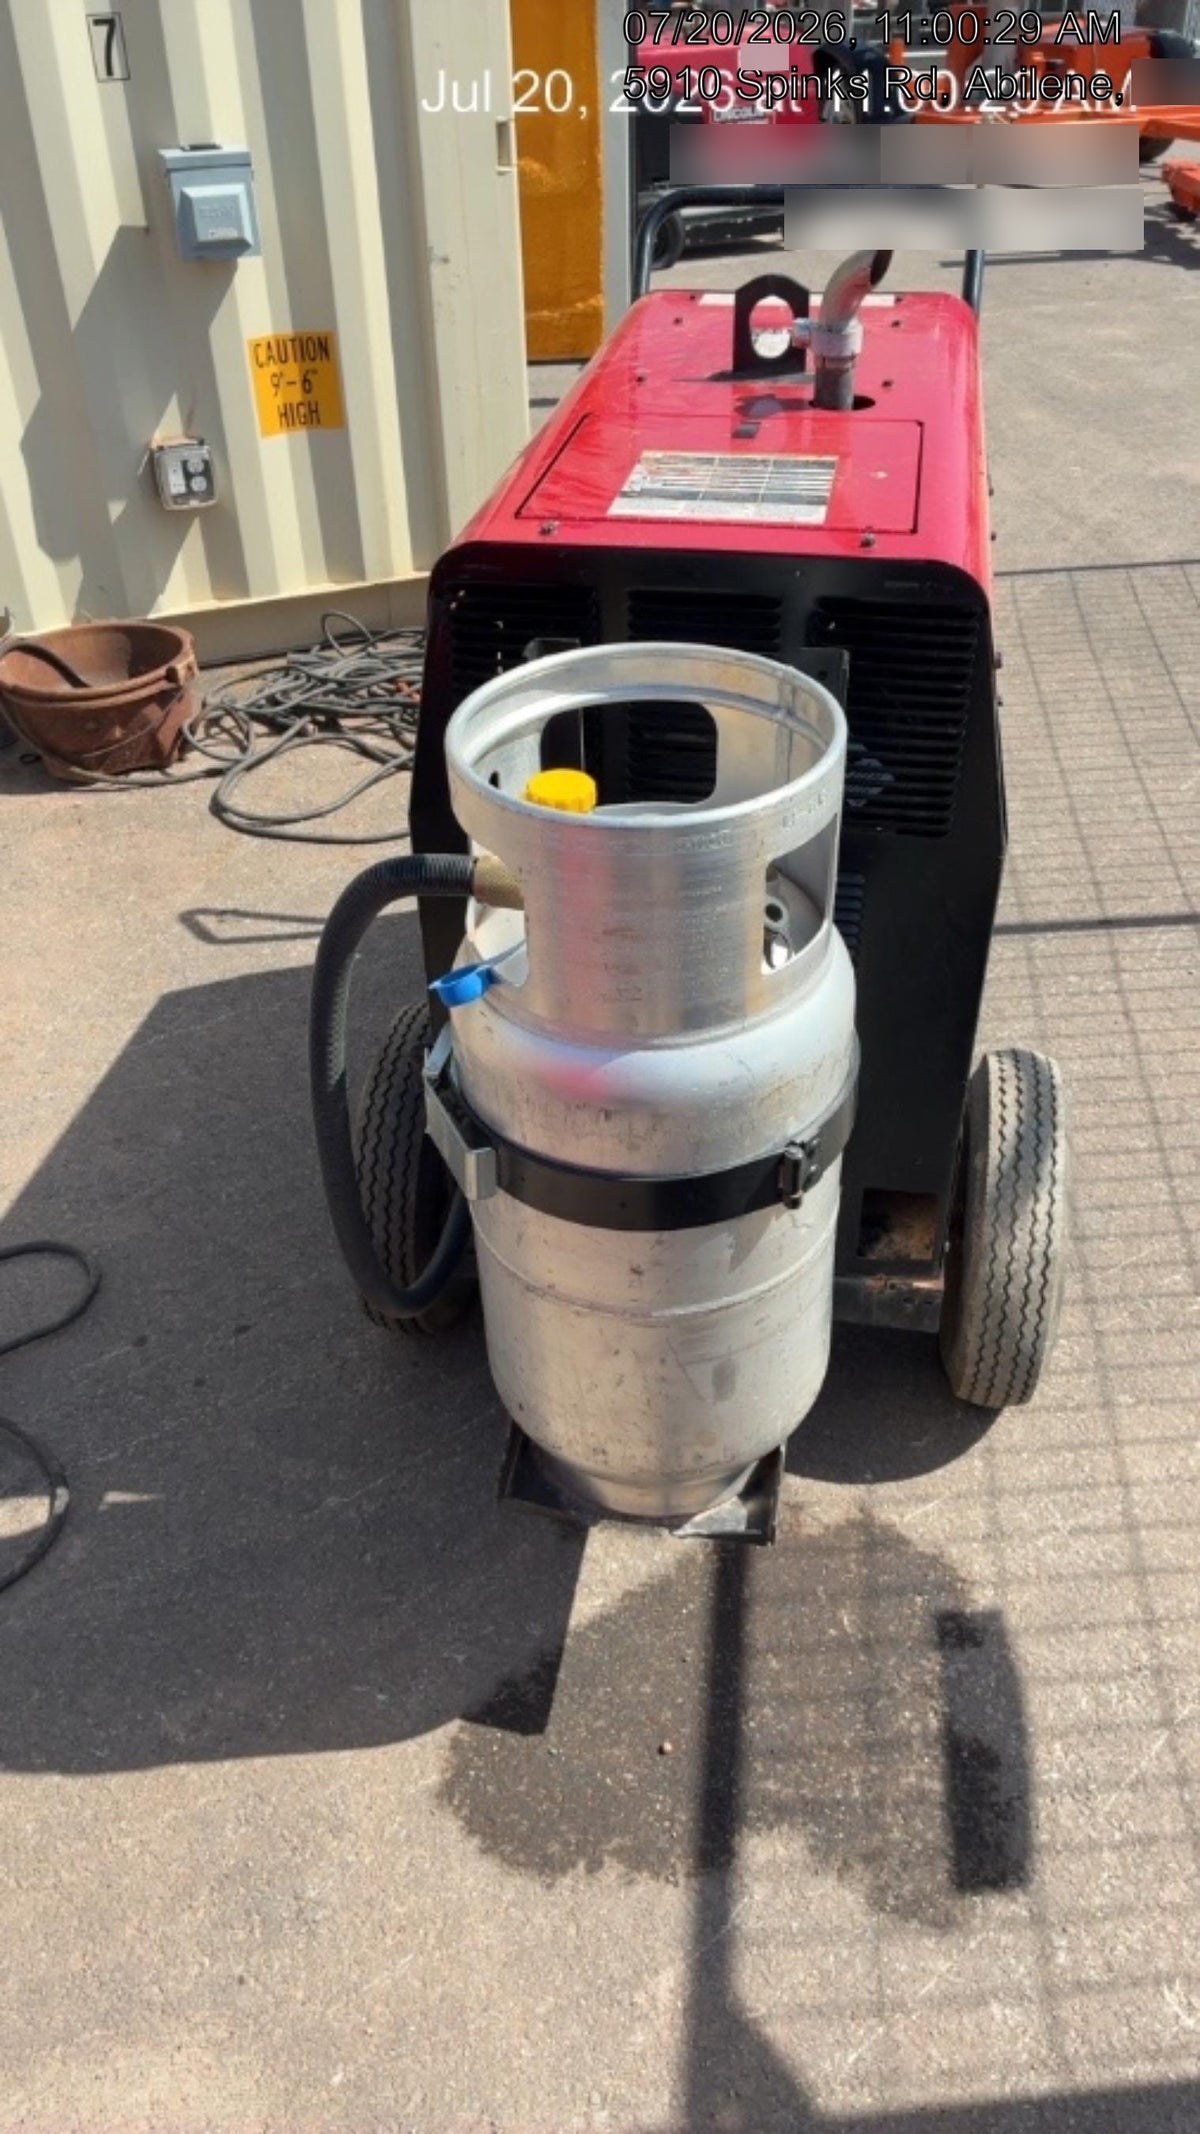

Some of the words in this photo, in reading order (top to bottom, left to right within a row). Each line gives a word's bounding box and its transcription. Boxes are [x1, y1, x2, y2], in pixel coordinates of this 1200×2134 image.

[92, 18, 116, 77] 7
[253, 336, 330, 368] CAUTION
[277, 400, 321, 429] HIGH
